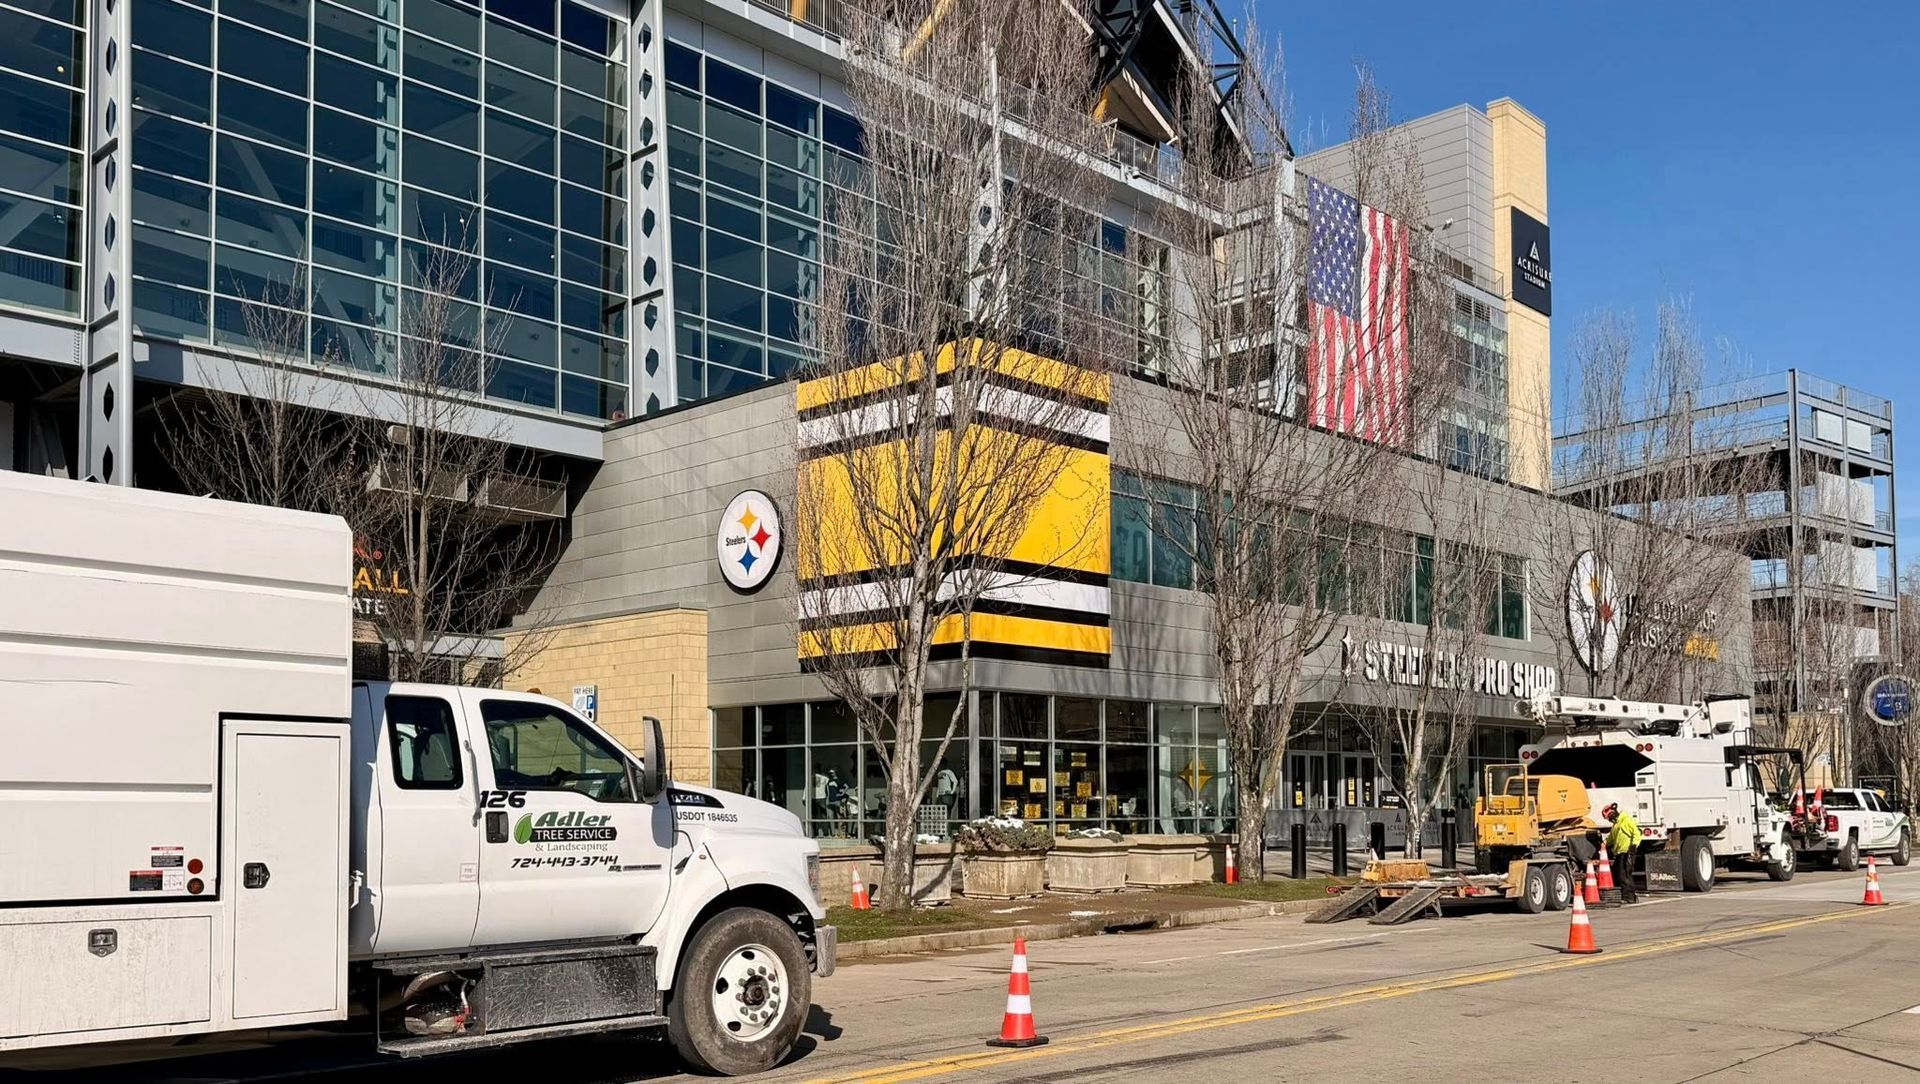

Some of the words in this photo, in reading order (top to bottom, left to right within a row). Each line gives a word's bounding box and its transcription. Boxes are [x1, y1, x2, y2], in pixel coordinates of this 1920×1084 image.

[1517, 256, 1552, 282] ACRISURE
[1523, 272, 1545, 289] STADIUM
[725, 535, 747, 547] Steelers
[1473, 656, 1508, 696] PRO
[1512, 662, 1556, 699] SHOP
[480, 791, 527, 808] 126
[534, 811, 611, 827] Adler
[676, 811, 705, 821] USDOT
[536, 829, 564, 840] TREE
[567, 828, 611, 840] SERVICE
[535, 843, 544, 852] &
[547, 842, 608, 852] Landscaping
[511, 855, 618, 869] 724-443-3744
